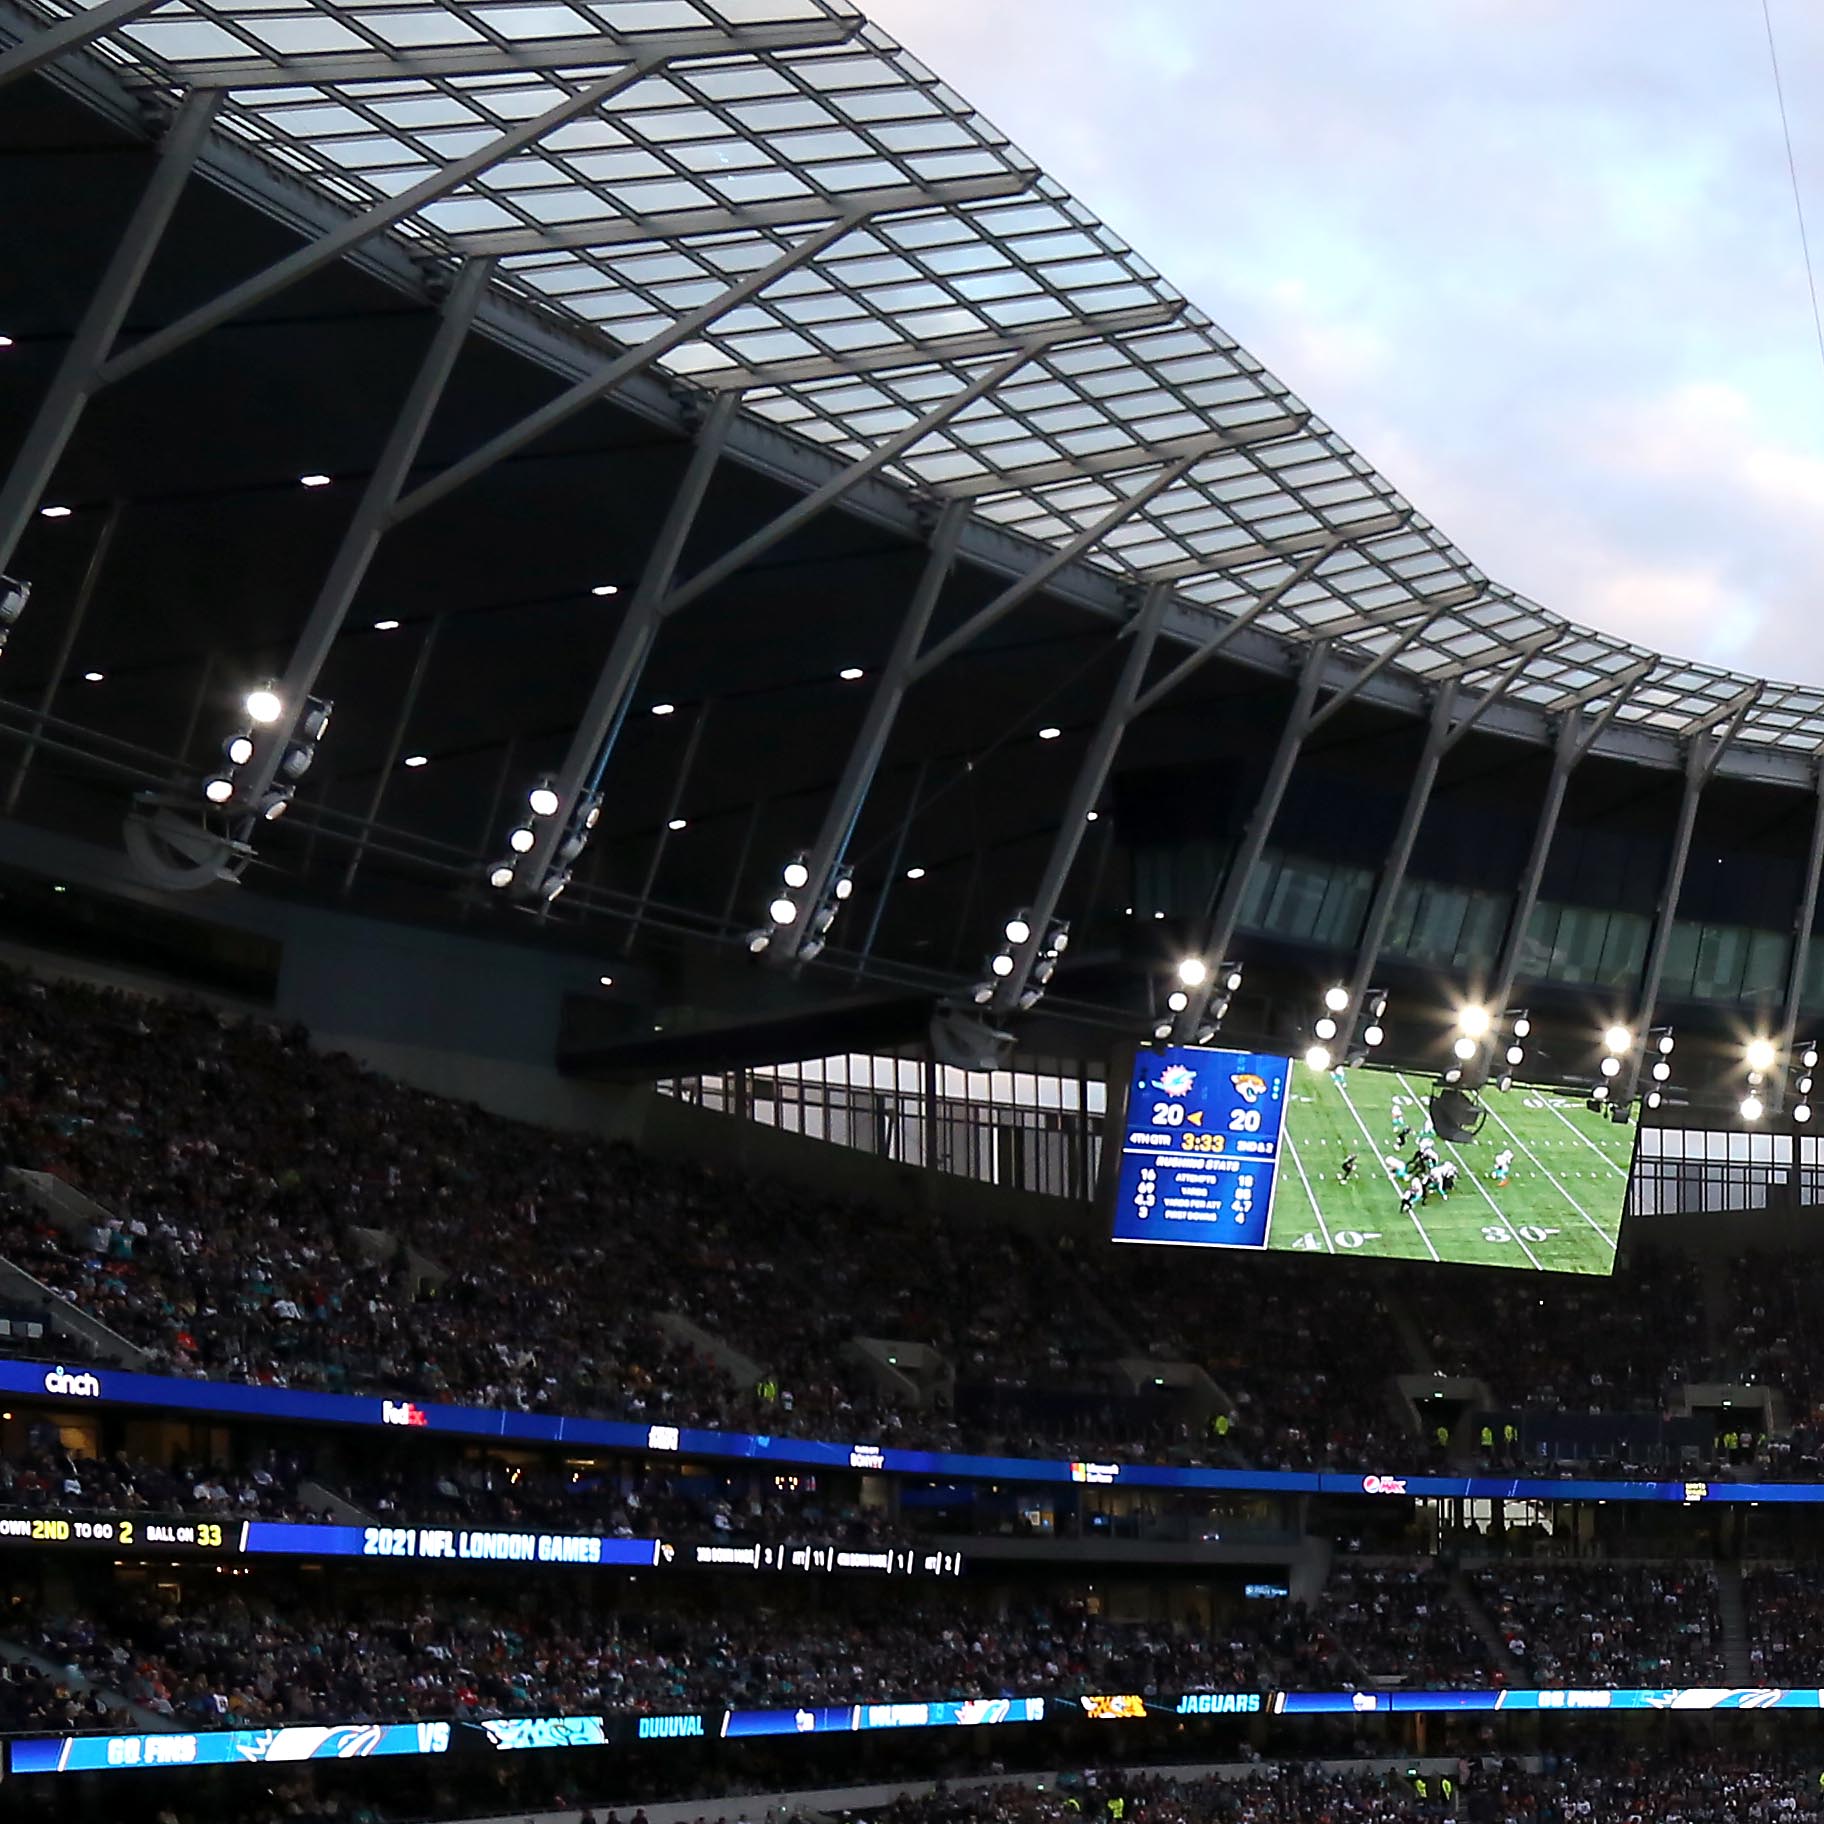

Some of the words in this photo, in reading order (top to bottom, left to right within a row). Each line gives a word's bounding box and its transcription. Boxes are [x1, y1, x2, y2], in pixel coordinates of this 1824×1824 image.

[1152, 1103, 1184, 1126] 20
[1229, 1109, 1261, 1132] 20
[1181, 1133, 1225, 1152] 3:33
[1231, 1201, 1253, 1212] 4.7
[45, 1366, 99, 1397] cinch
[383, 1400, 427, 1426] FedEx
[32, 1520, 69, 1540] 2ND
[74, 1522, 92, 1538] TO
[93, 1523, 113, 1539] GO
[118, 1522, 133, 1544] 2
[146, 1525, 176, 1542] BALL
[177, 1527, 194, 1543] ON
[197, 1524, 222, 1546] 33
[364, 1527, 416, 1556] 2021
[419, 1529, 456, 1558] NFL
[459, 1531, 536, 1561] LONDON
[538, 1536, 602, 1562] GAMES
[1026, 1698, 1044, 1721] VS
[1177, 1693, 1260, 1714] JAGUARS
[418, 1722, 451, 1753] VS
[639, 1715, 704, 1738] DUUUVAL
[107, 1738, 141, 1765] GO
[144, 1736, 198, 1763] FINS
